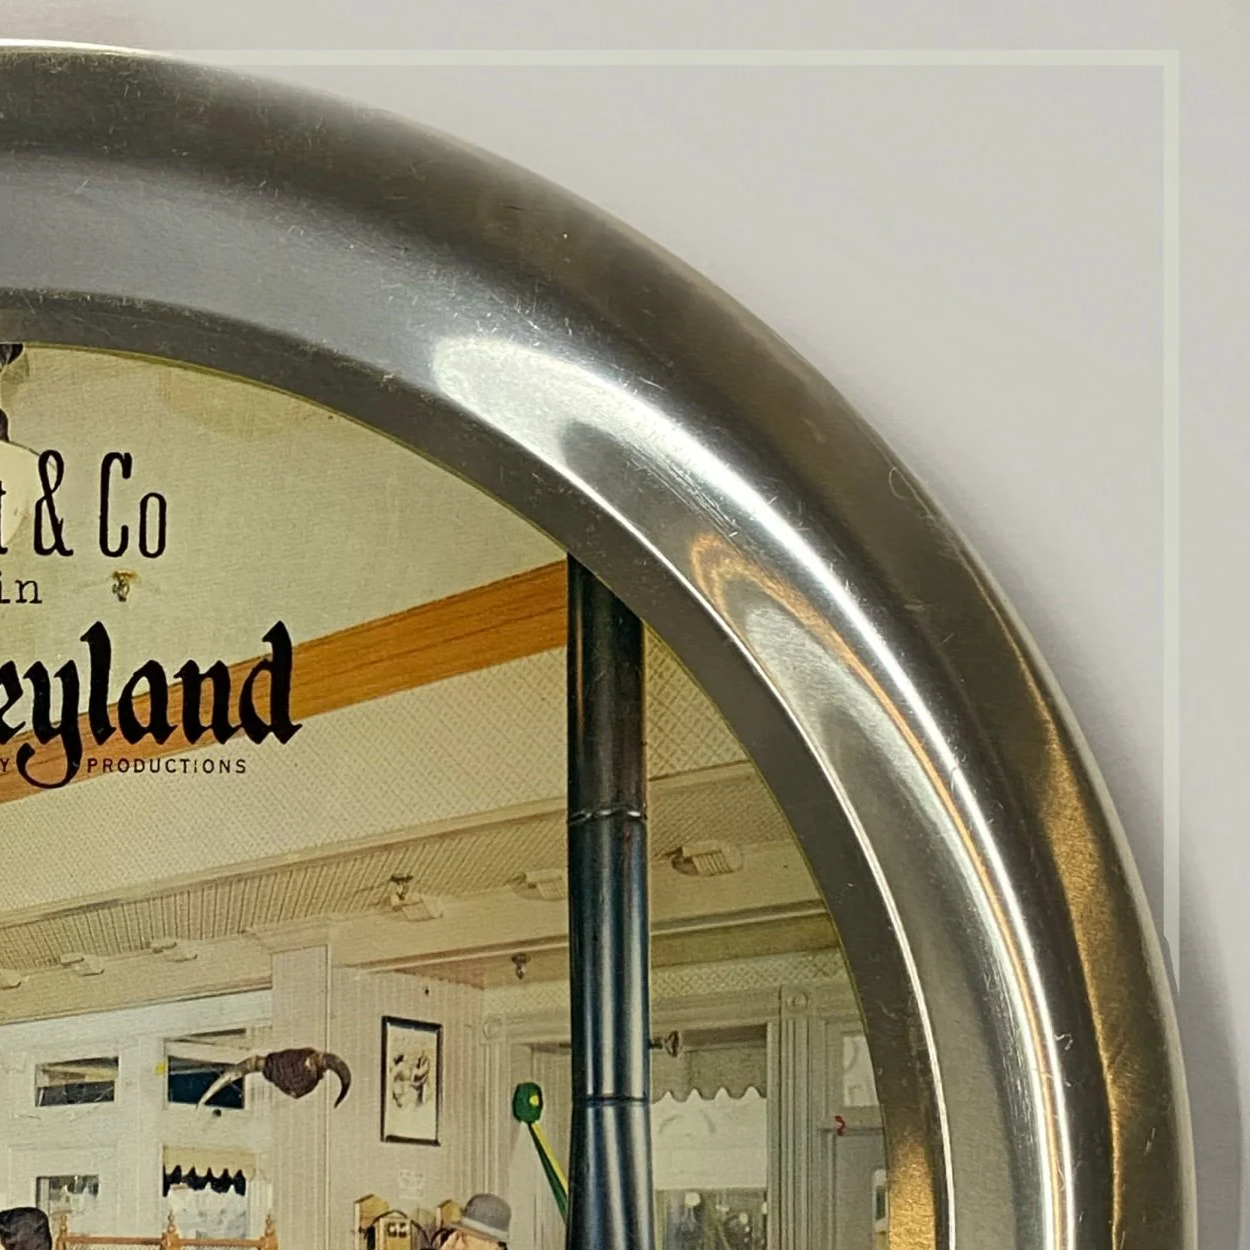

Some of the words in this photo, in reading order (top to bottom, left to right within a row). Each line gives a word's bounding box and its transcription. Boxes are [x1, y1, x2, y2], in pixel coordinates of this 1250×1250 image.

[33, 449, 74, 557] &
[98, 451, 167, 558] Co
[87, 758, 246, 774] PRODUCTIONS
